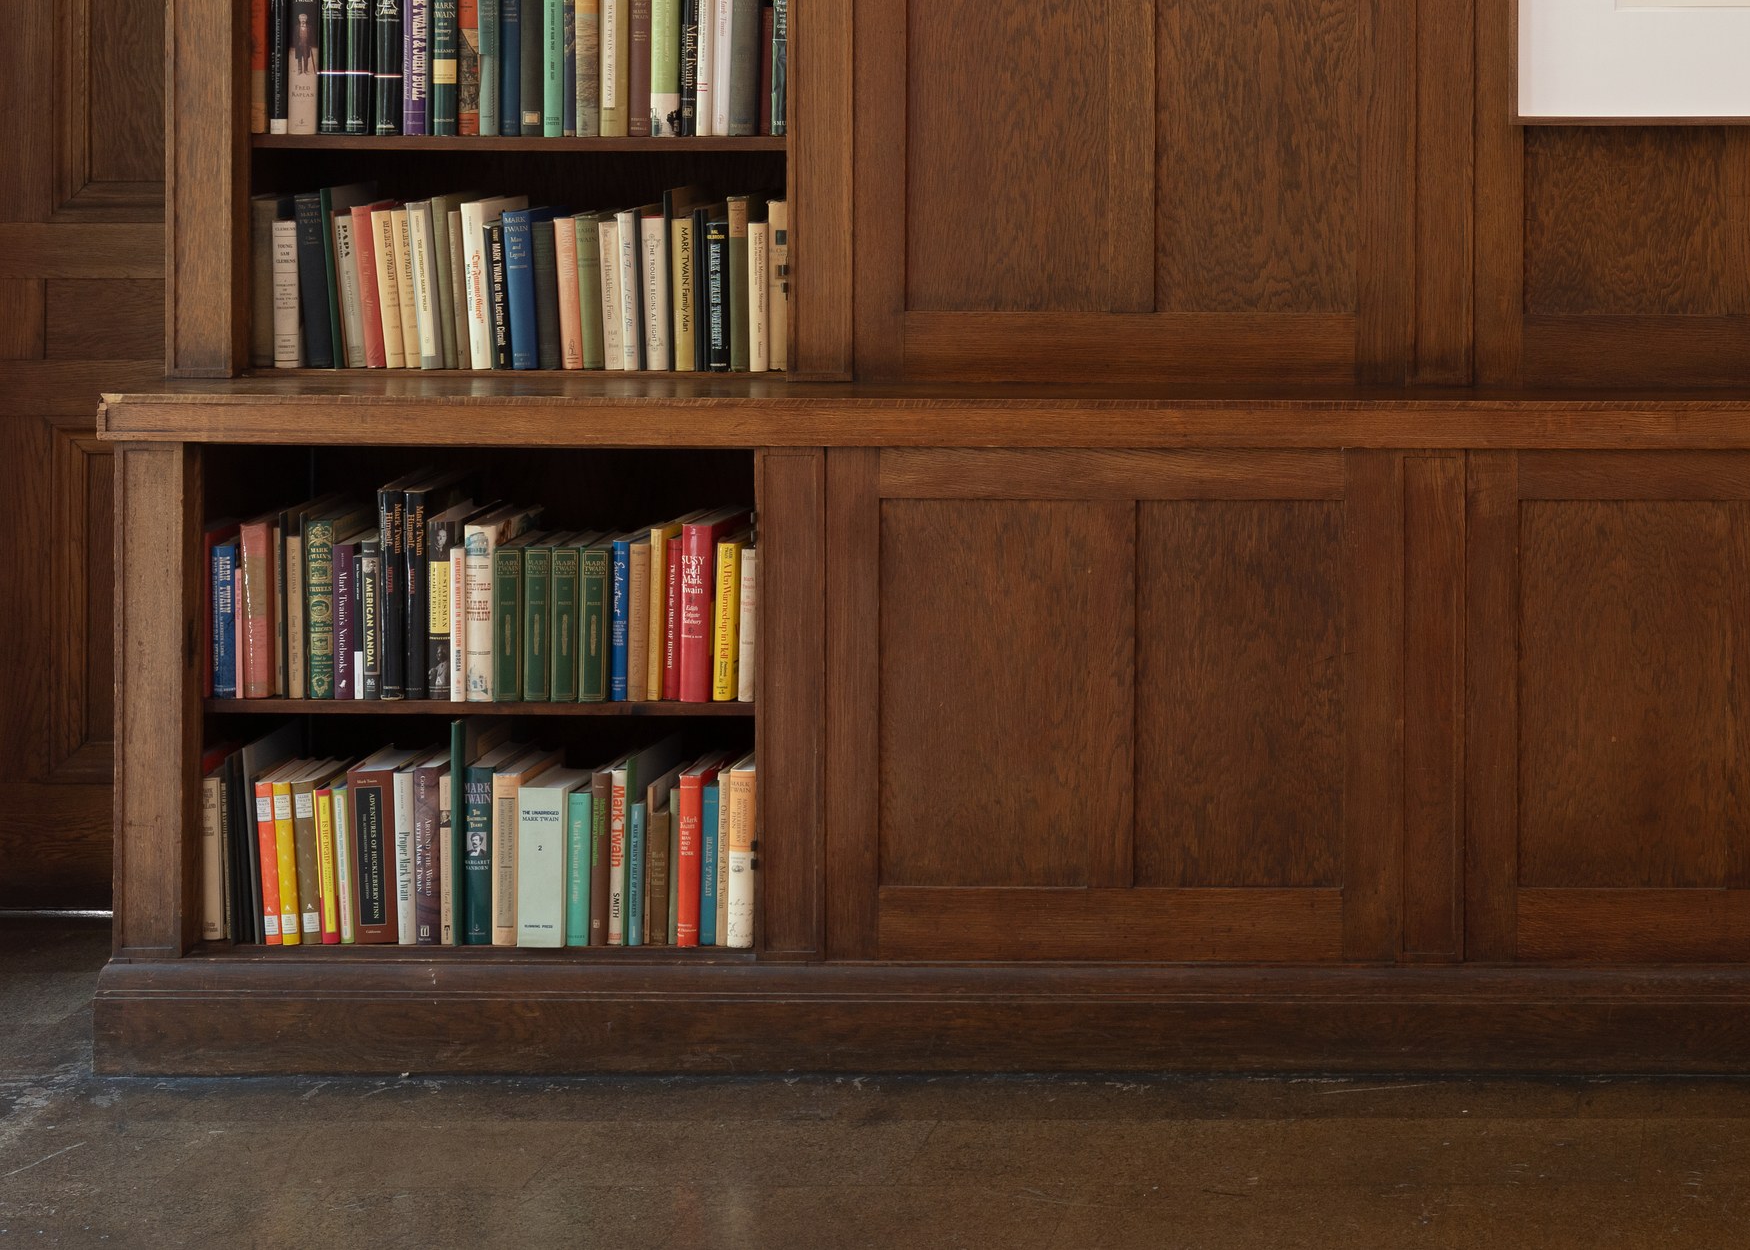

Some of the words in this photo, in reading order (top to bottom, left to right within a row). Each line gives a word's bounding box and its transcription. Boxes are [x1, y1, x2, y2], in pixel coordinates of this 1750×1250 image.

[412, 8, 426, 39] TWAIN
[413, 40, 426, 48] &
[412, 49, 426, 74] JOHN
[412, 76, 426, 100] BULL
[681, 227, 689, 252] MARK
[492, 243, 500, 260] MARK
[493, 263, 502, 282] TWAIN
[495, 293, 503, 302] the
[681, 288, 690, 312] Family
[495, 303, 504, 325] Lecture
[497, 327, 506, 345] Circuit
[724, 561, 732, 569] A
[339, 572, 347, 593] Mark
[723, 571, 732, 584] Pen
[339, 595, 347, 626] Twain's
[720, 585, 731, 633] Warmed-up
[339, 629, 347, 672] Notebooks
[720, 643, 730, 659] Hell
[612, 785, 624, 822] Mark
[371, 840, 377, 850] OF
[612, 825, 624, 867] Twain
